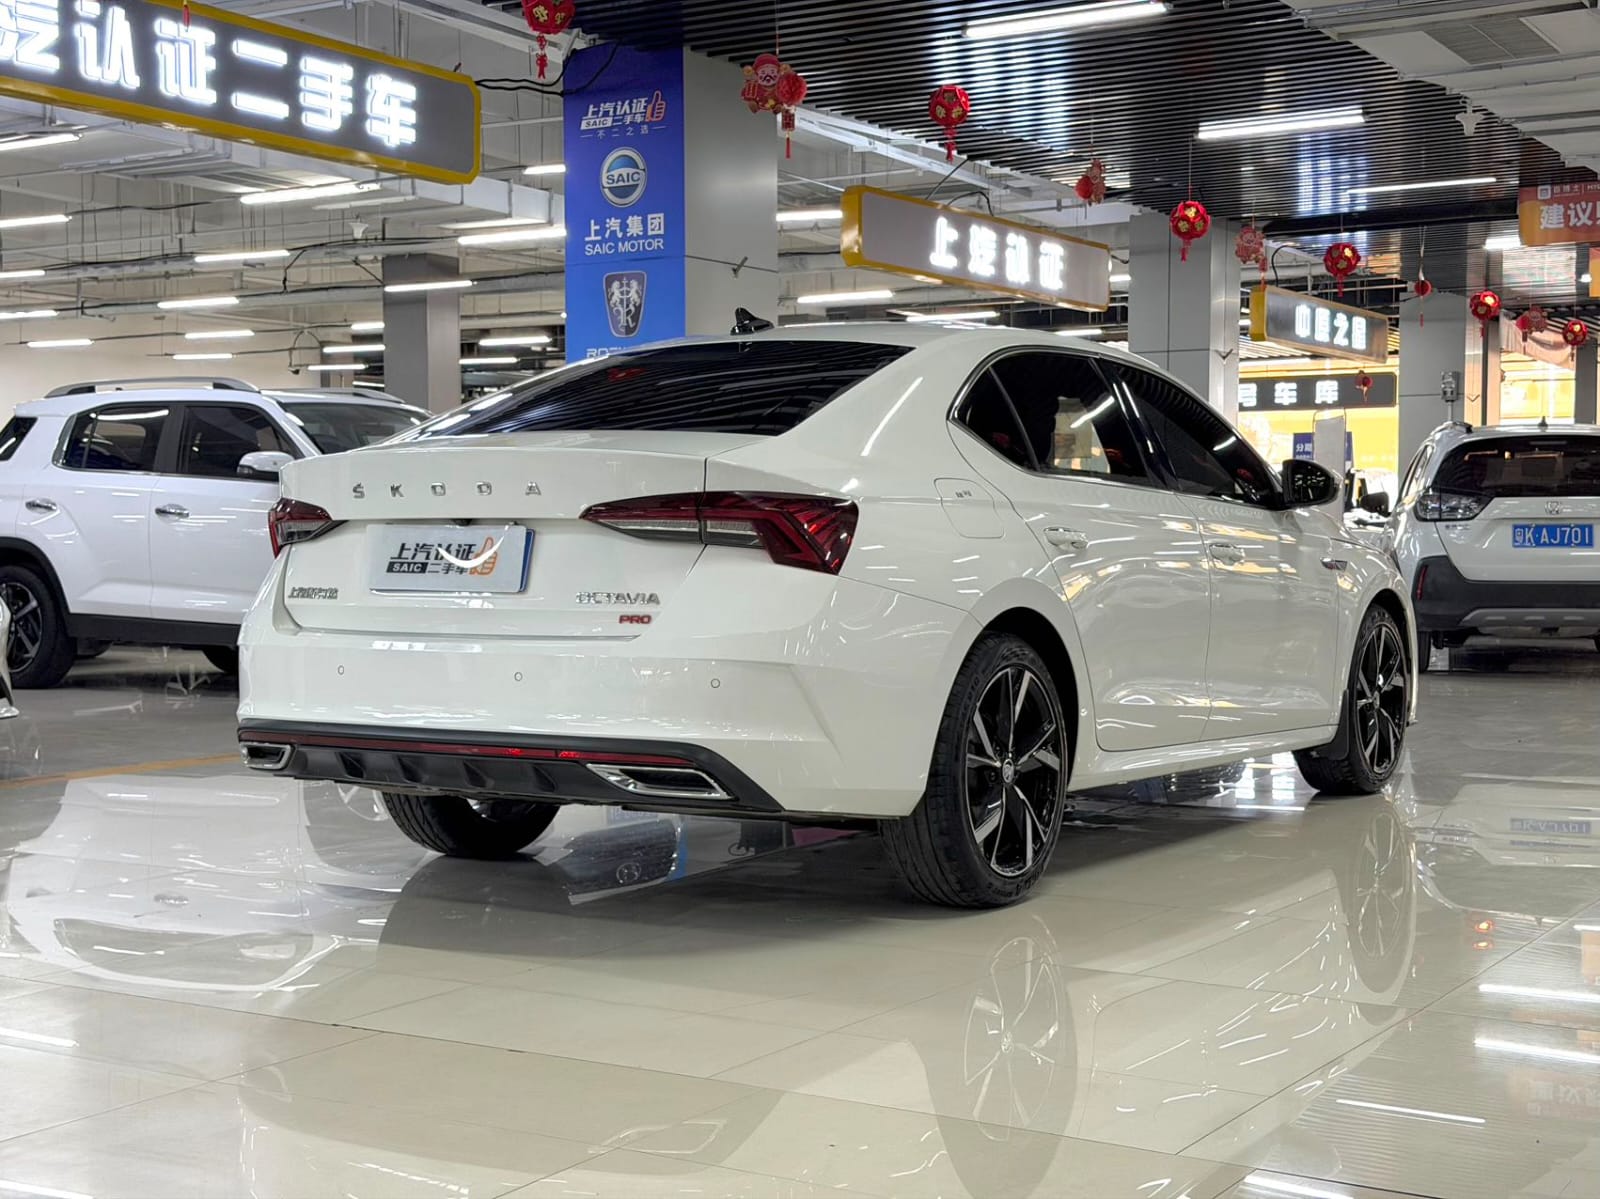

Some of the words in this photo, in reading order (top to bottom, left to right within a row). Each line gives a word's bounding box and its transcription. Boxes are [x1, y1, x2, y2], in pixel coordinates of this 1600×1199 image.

[582, 97, 648, 120] 上汽认证
[584, 118, 609, 128] SAIC
[612, 113, 645, 125] 二手车
[606, 171, 641, 185] SAIC
[1540, 201, 1600, 230] 建议
[584, 213, 664, 241] 上汽集团
[585, 241, 615, 256] SAIC
[618, 239, 664, 254] MOTOR
[390, 542, 476, 561] 上汽认证
[392, 563, 422, 572] SAIC
[576, 591, 660, 605] OCTAVIA
[619, 614, 651, 624] PRO
